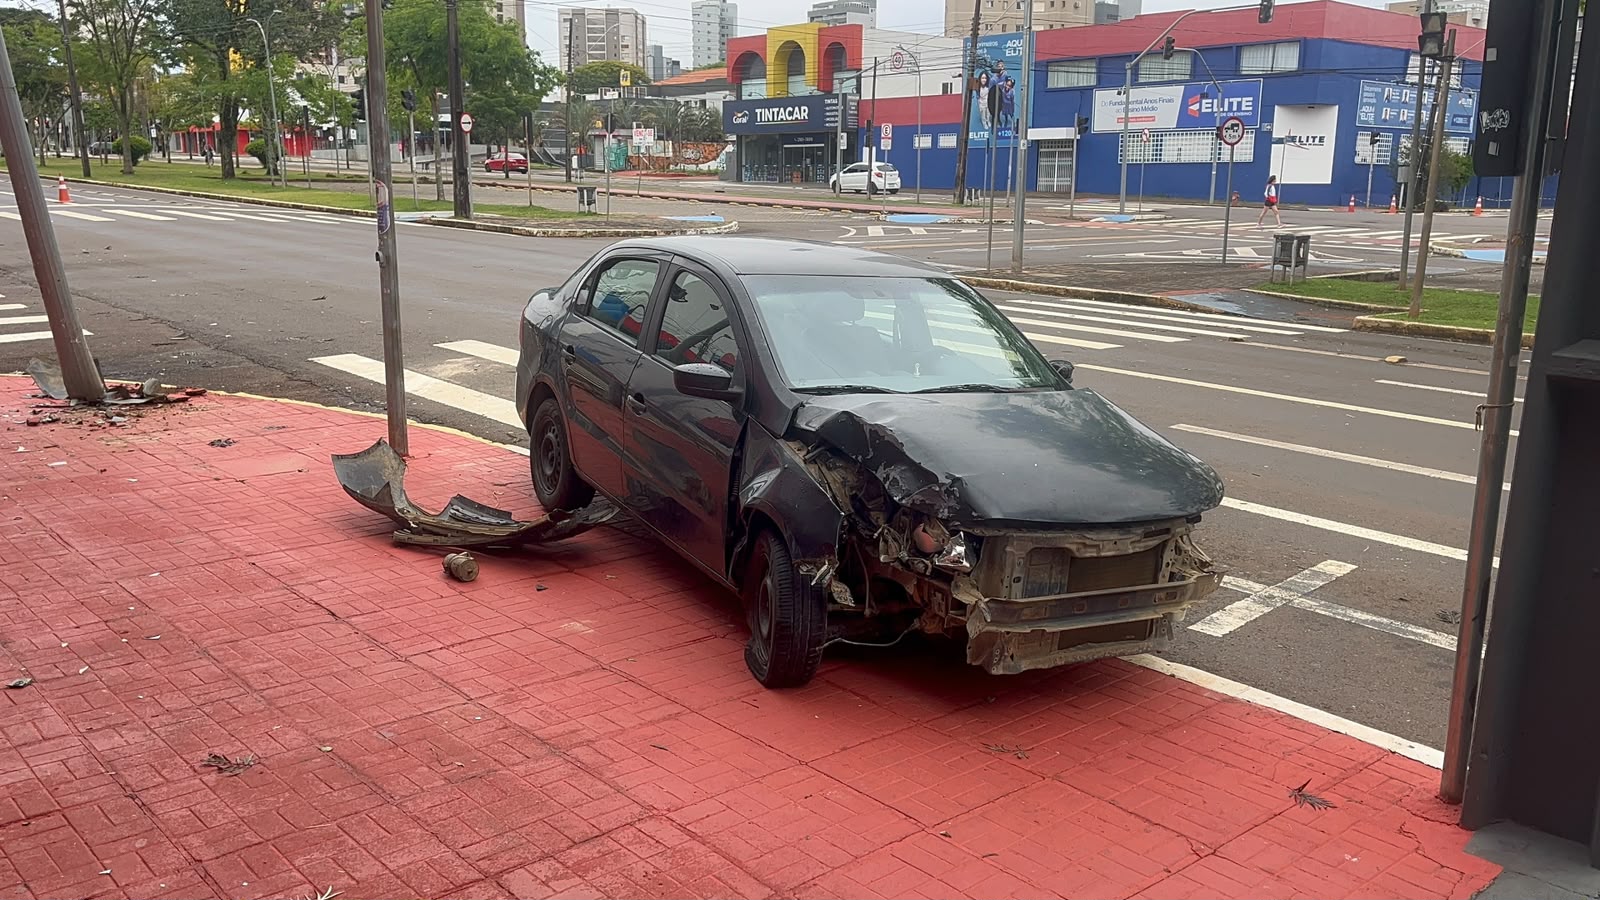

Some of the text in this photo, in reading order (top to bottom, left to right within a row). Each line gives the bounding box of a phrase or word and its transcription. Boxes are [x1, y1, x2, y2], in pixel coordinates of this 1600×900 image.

[1006, 39, 1023, 47] AQU
[1109, 98, 1143, 106] Fundaental
[1158, 96, 1175, 104] Finais
[1201, 97, 1253, 112] ELITE
[755, 106, 809, 122] TINTACAR
[733, 115, 747, 124] Coral
[969, 131, 989, 139] ELITE
